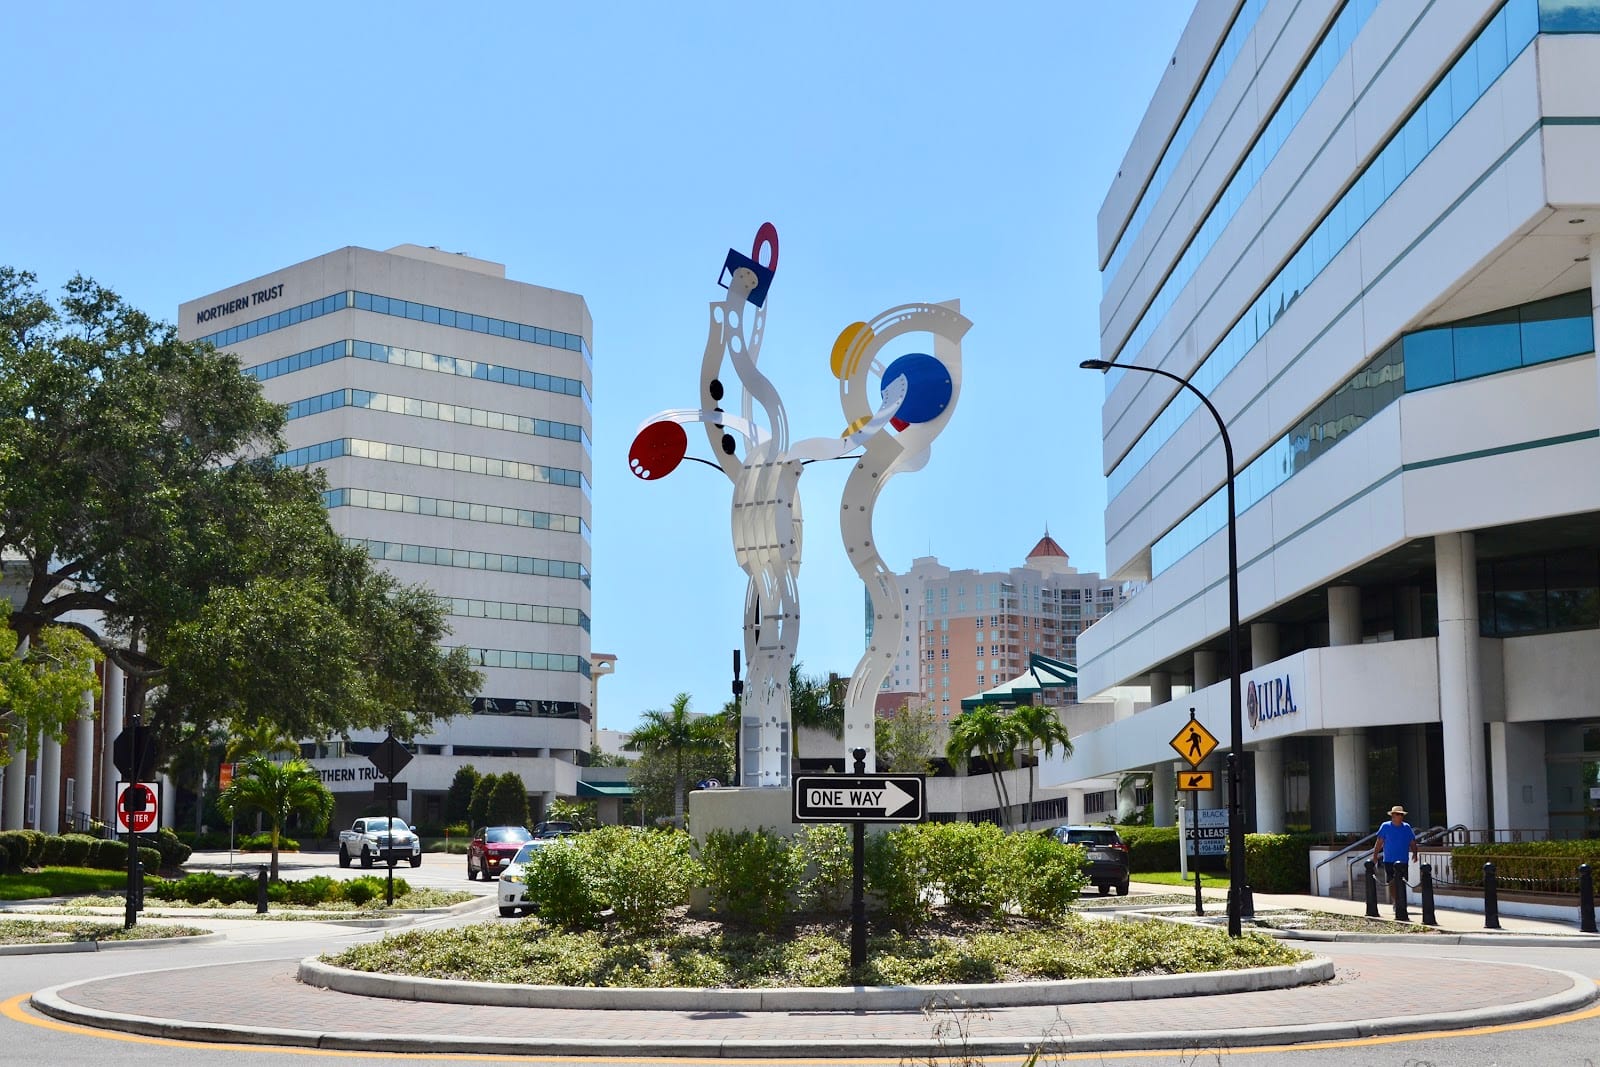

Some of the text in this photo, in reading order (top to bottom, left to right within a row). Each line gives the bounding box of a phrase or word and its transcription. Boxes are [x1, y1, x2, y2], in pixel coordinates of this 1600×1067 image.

[196, 284, 284, 325] NORTHERN TRUST
[315, 767, 385, 782] RTHERN TRUS
[811, 791, 883, 806] ONE WAY
[125, 814, 149, 823] ETER
[1202, 810, 1224, 818] BLACK
[1203, 828, 1230, 838] LEASE
